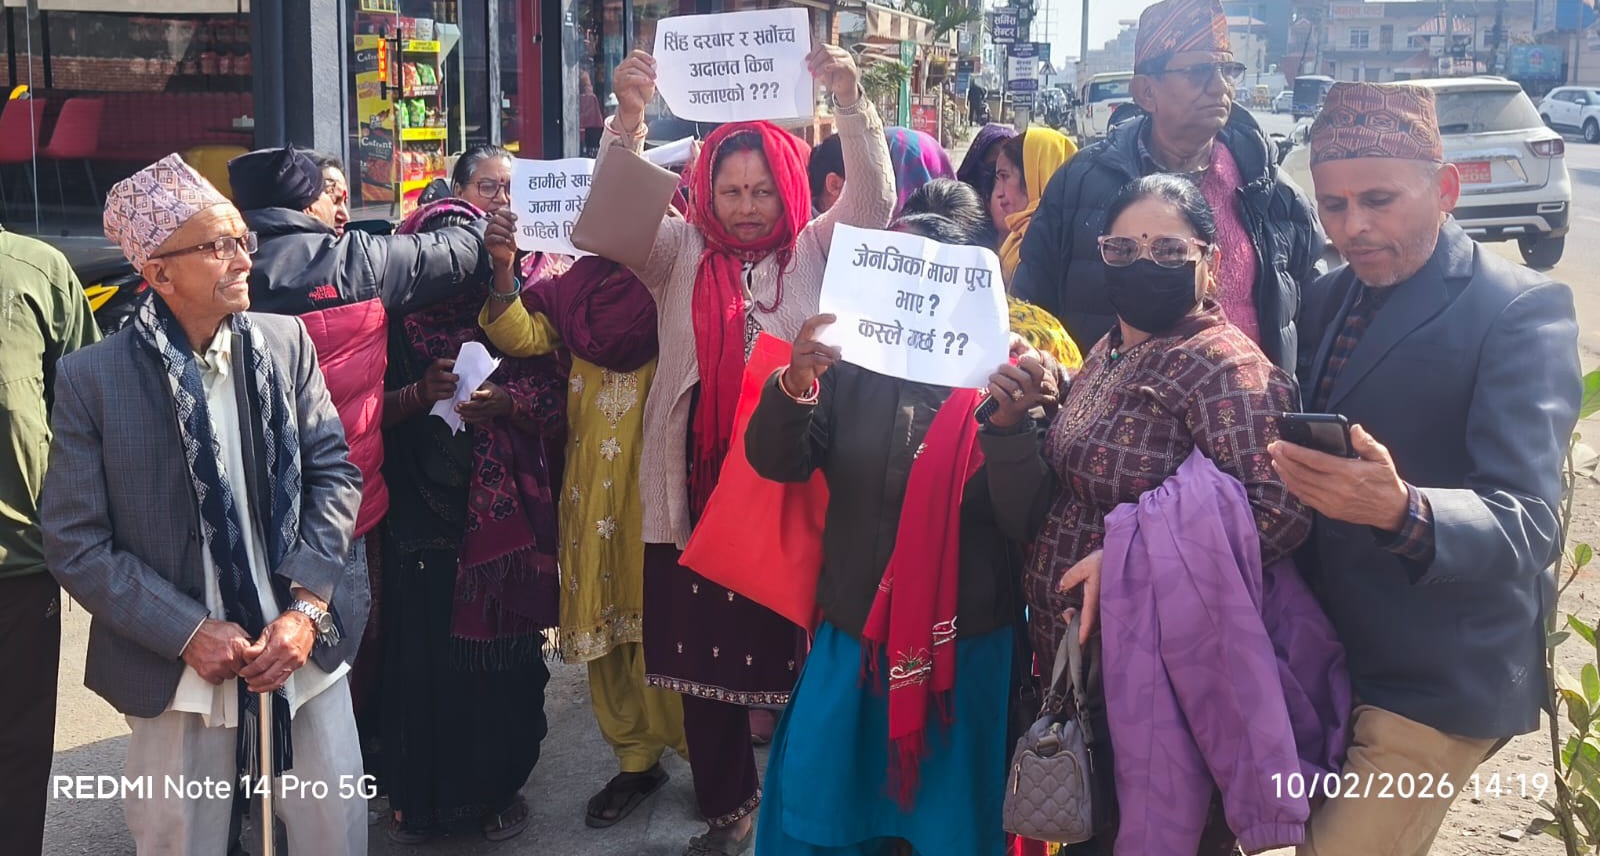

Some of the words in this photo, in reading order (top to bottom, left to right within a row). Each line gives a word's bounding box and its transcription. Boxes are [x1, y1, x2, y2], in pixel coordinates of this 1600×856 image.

[664, 31, 688, 51] सिंह
[693, 32, 735, 50] दरबार
[739, 32, 748, 46] र
[753, 25, 795, 45] सर्वोच्च
[689, 59, 739, 77] अदालत
[744, 54, 774, 74] किन
[688, 83, 744, 104] जलाएको
[750, 81, 779, 100] ???
[528, 171, 567, 190] हामीले
[528, 200, 561, 214] जम्मा
[522, 221, 559, 239] कहिले
[852, 243, 926, 278] जेनजिका
[927, 262, 960, 284] माग
[965, 267, 992, 292] पुरा
[895, 290, 925, 313] भाए
[929, 294, 940, 316] ?
[858, 319, 904, 345] कस्ले
[943, 331, 969, 356] ??
